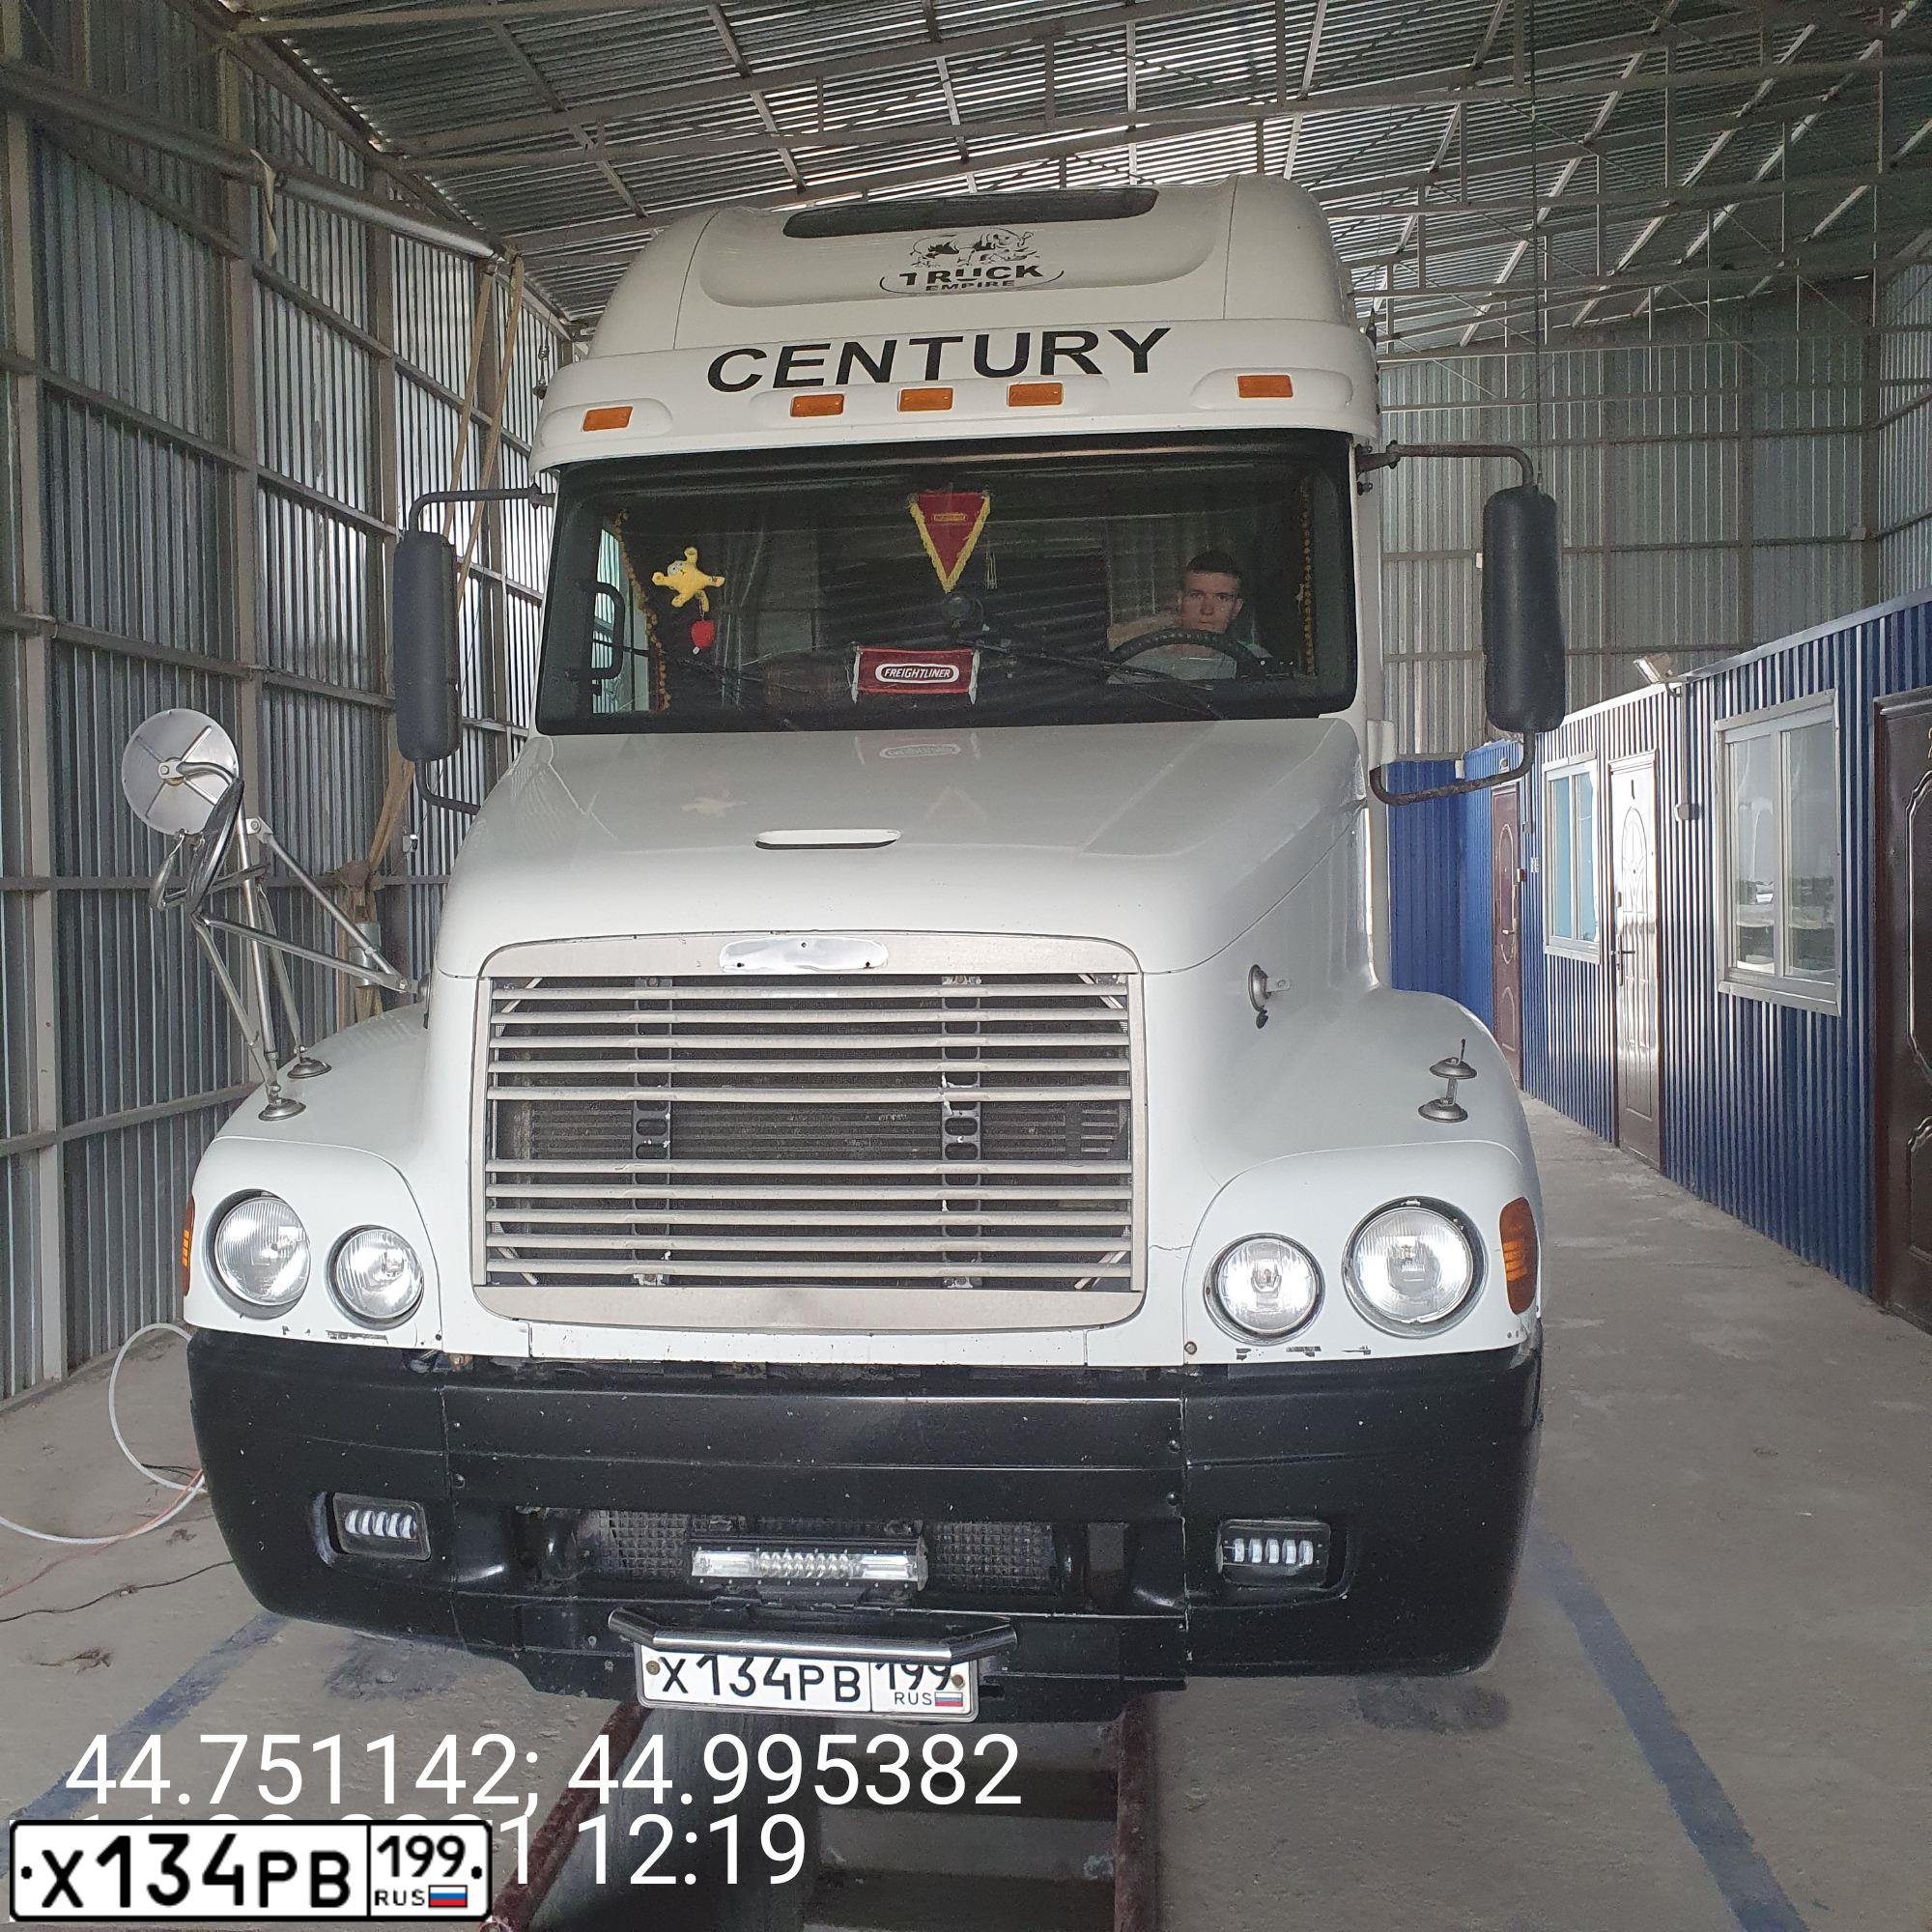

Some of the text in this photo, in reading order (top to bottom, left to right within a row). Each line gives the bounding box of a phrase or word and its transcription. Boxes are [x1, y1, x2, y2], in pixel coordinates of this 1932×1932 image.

[899, 265, 1043, 285] TRUCK
[925, 280, 1014, 292] EMPIRE
[707, 327, 1171, 392] CENTURY
[884, 668, 951, 678] FREIGHTLINER
[895, 1691, 931, 1706] RUS
